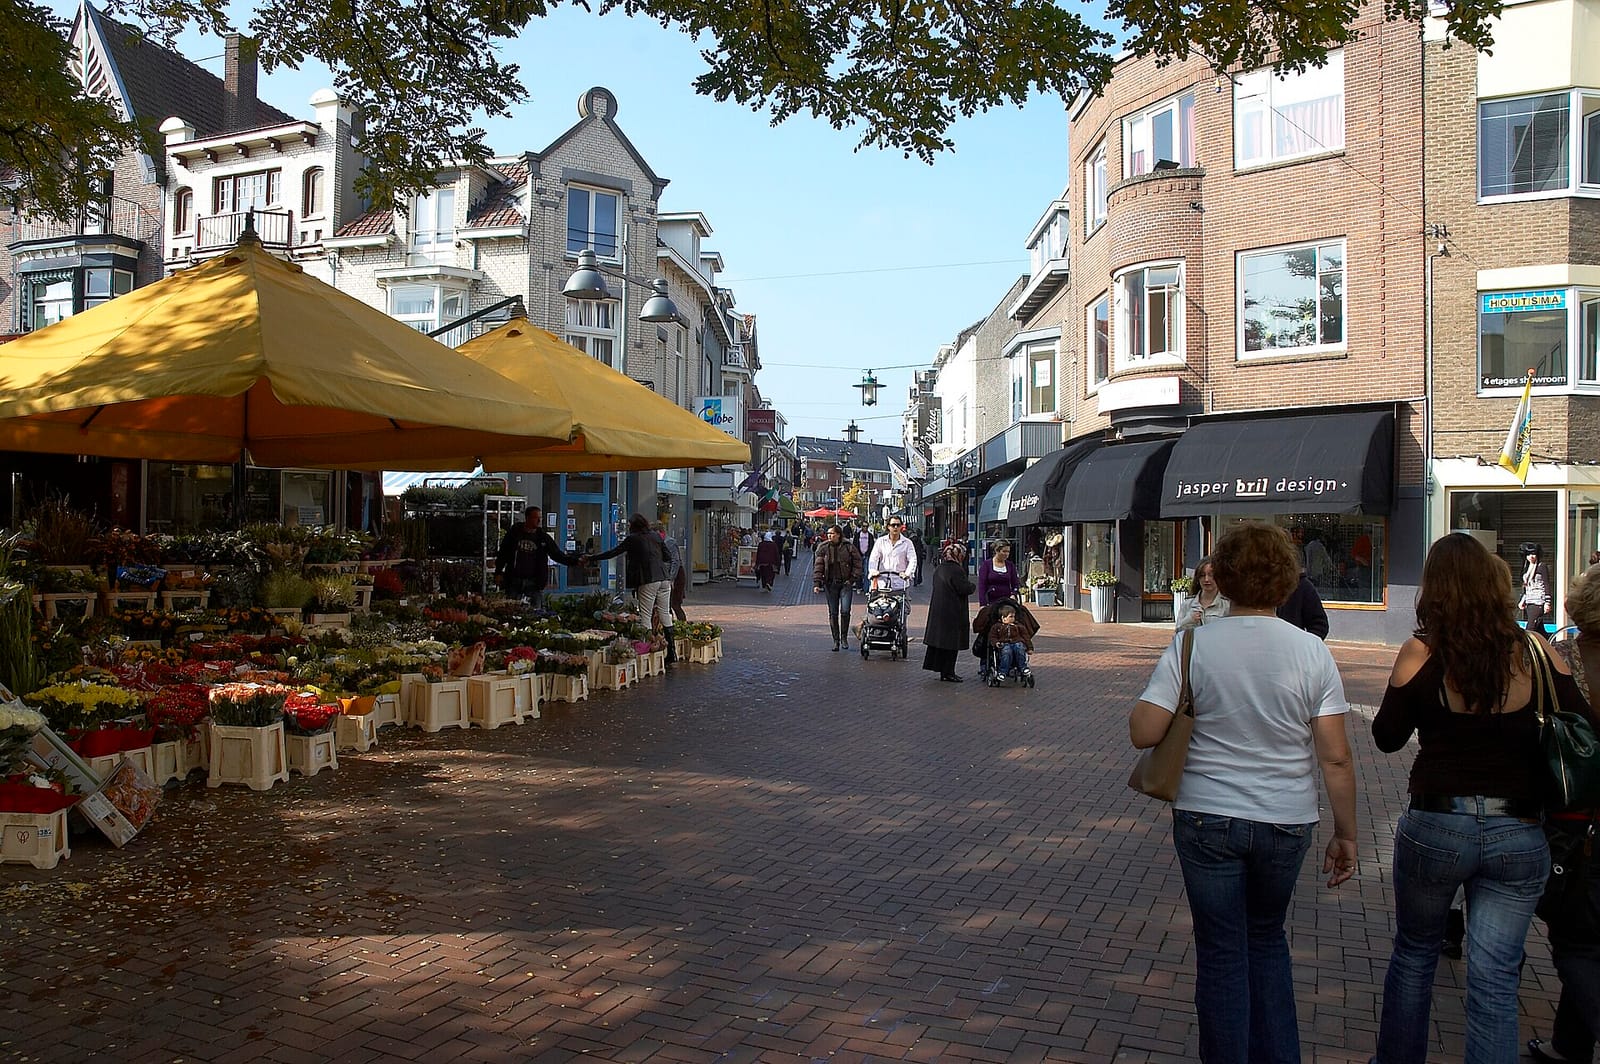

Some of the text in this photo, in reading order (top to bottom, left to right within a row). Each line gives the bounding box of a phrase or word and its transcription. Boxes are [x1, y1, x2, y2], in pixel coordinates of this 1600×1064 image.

[1489, 296, 1559, 308] HOUTSMA
[1484, 377, 1489, 385] 4
[1490, 378, 1518, 386] etages
[1176, 476, 1337, 498] jasper bril design
